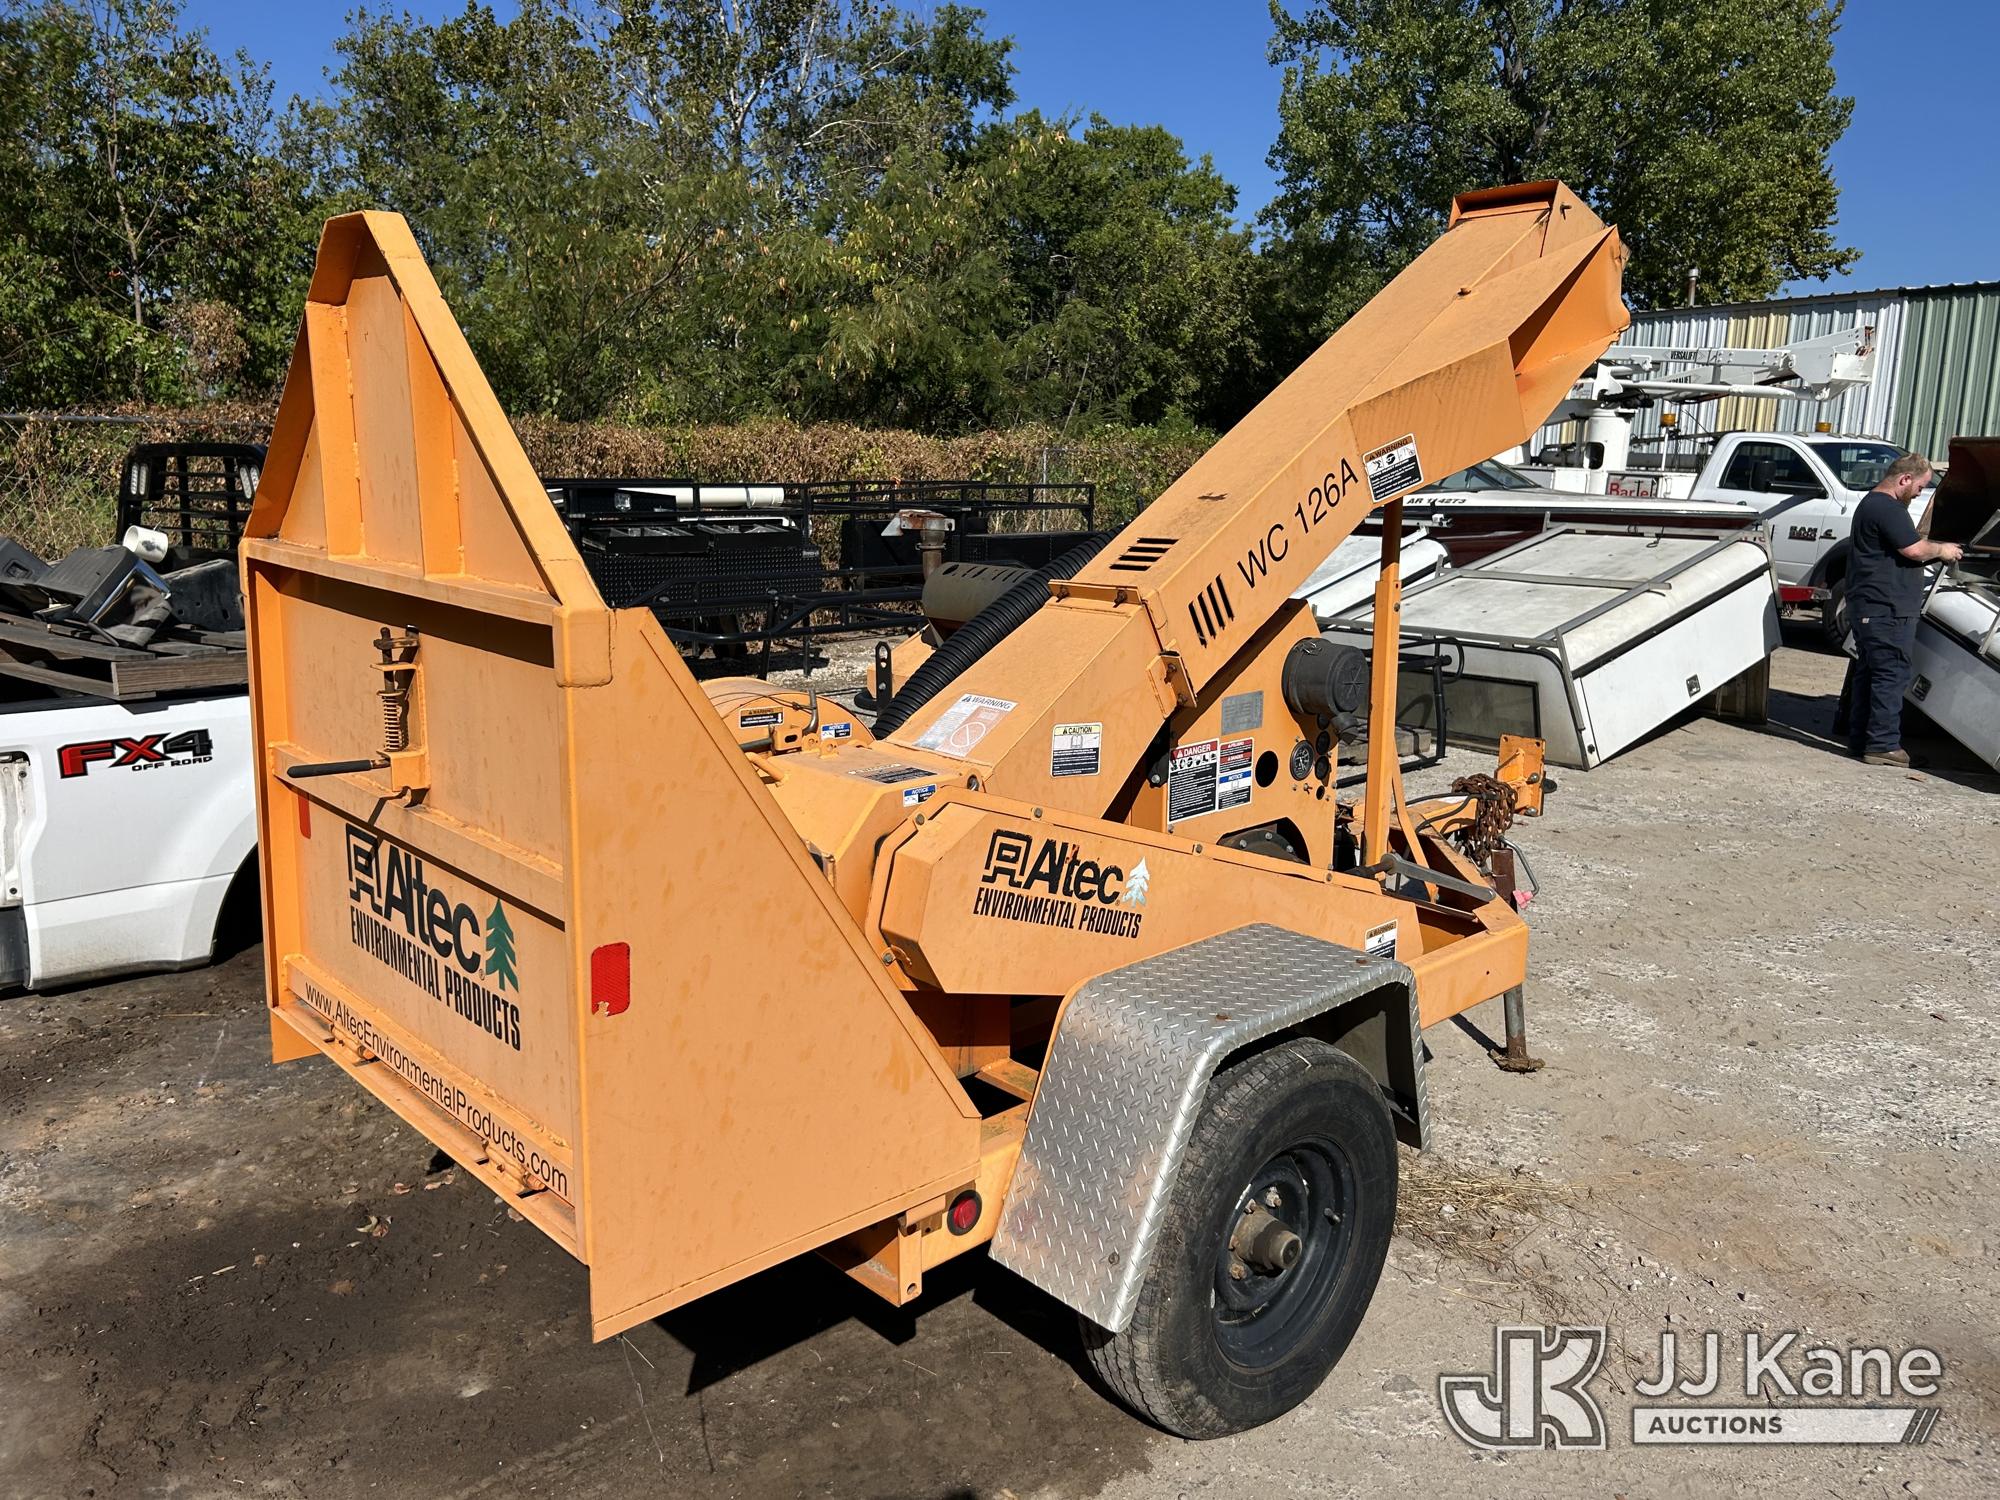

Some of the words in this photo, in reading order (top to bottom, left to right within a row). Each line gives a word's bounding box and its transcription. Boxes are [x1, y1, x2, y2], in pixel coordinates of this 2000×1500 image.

[1670, 350, 1698, 361] VERSALIFT
[1374, 438, 1408, 457] WARNING
[1236, 523, 1289, 589] WC
[1294, 457, 1359, 534] 126A
[971, 696, 1013, 709] WARNING
[57, 728, 213, 779] FX4
[1068, 726, 1093, 734] CAUTION
[1183, 743, 1211, 757] DANGER
[131, 762, 165, 772] OFF
[170, 756, 213, 768] ROAD
[1022, 838, 1124, 905] Altec
[383, 844, 481, 974] Altec
[973, 887, 1077, 930] ENVIRONMENTAL
[1078, 904, 1142, 939] PRODUCTS
[350, 904, 442, 1002] ENVIRONMENTAL
[444, 965, 521, 1052] PRODUCTS
[305, 982, 568, 1197] www.AltecEnvironmentalProducts.com
